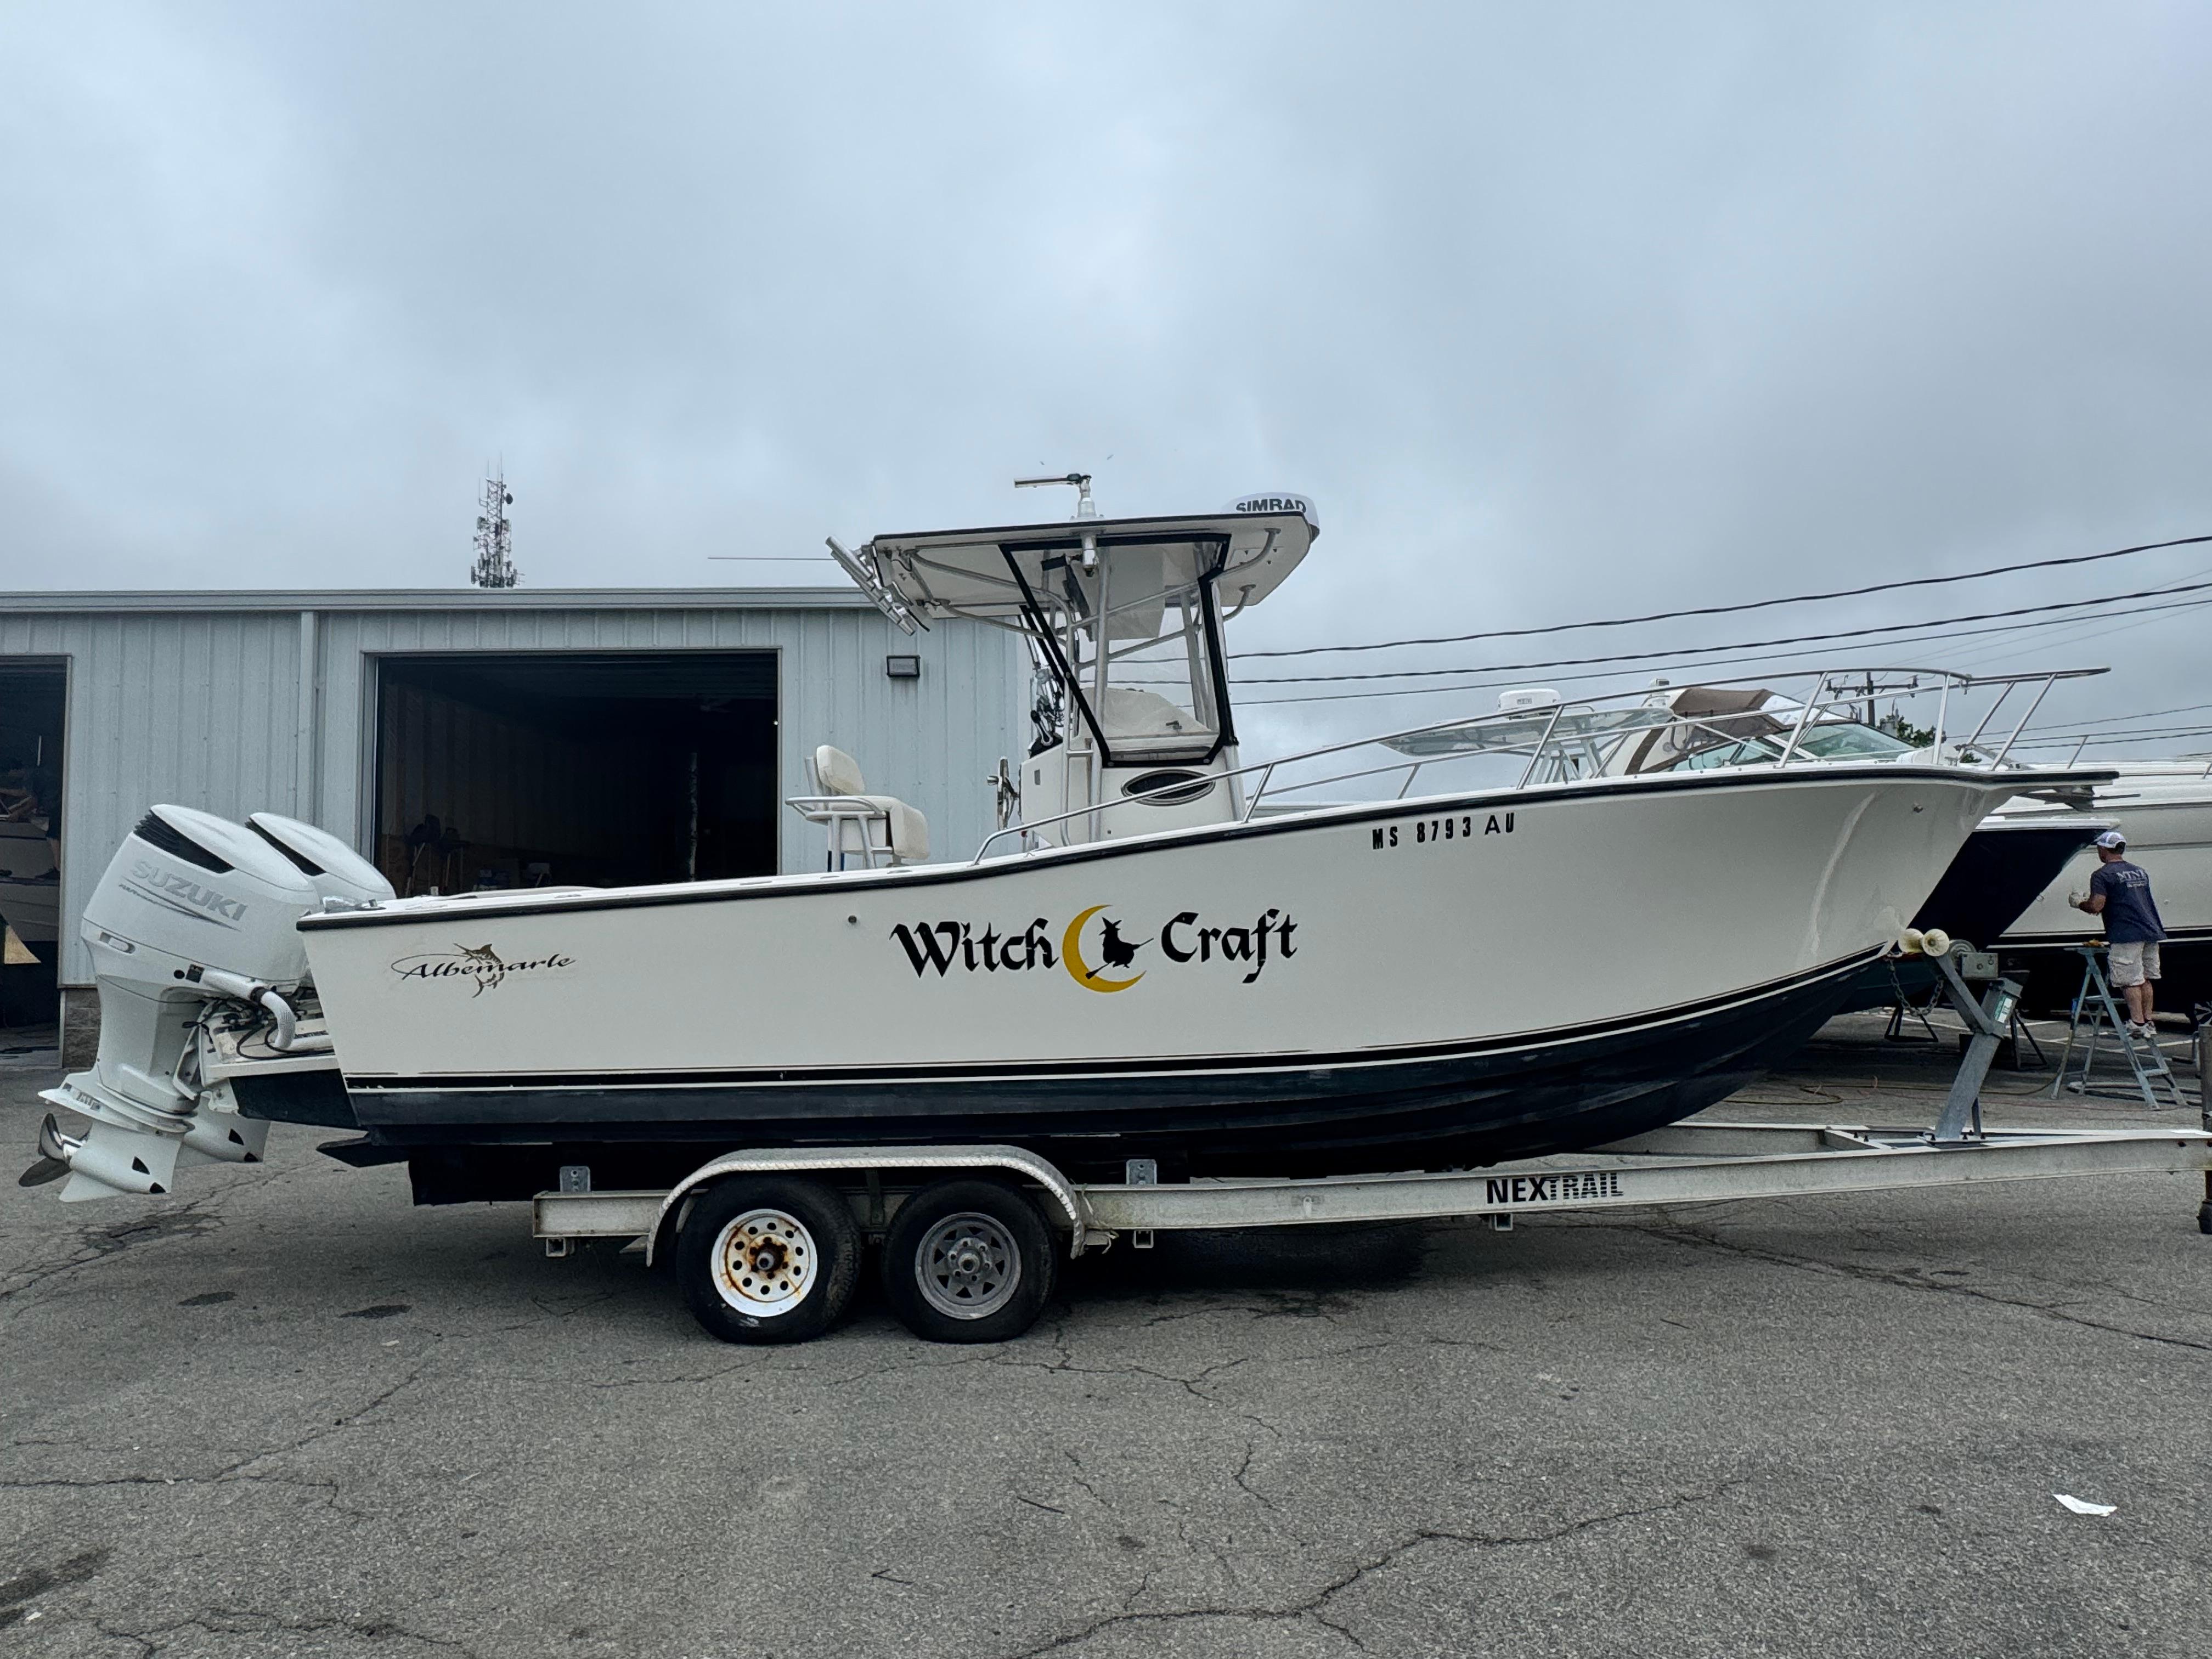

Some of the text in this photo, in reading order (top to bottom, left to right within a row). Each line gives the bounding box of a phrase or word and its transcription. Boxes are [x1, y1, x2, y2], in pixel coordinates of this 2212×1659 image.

[1235, 498, 1307, 514] SIMRAD
[1372, 812, 1515, 850] MS 8793 AU
[130, 860, 249, 922] SUZUKI
[889, 909, 1299, 984] Witch Craft
[391, 953, 576, 980] Albemarle
[1486, 1172, 1624, 1204] NEXTRAIL
